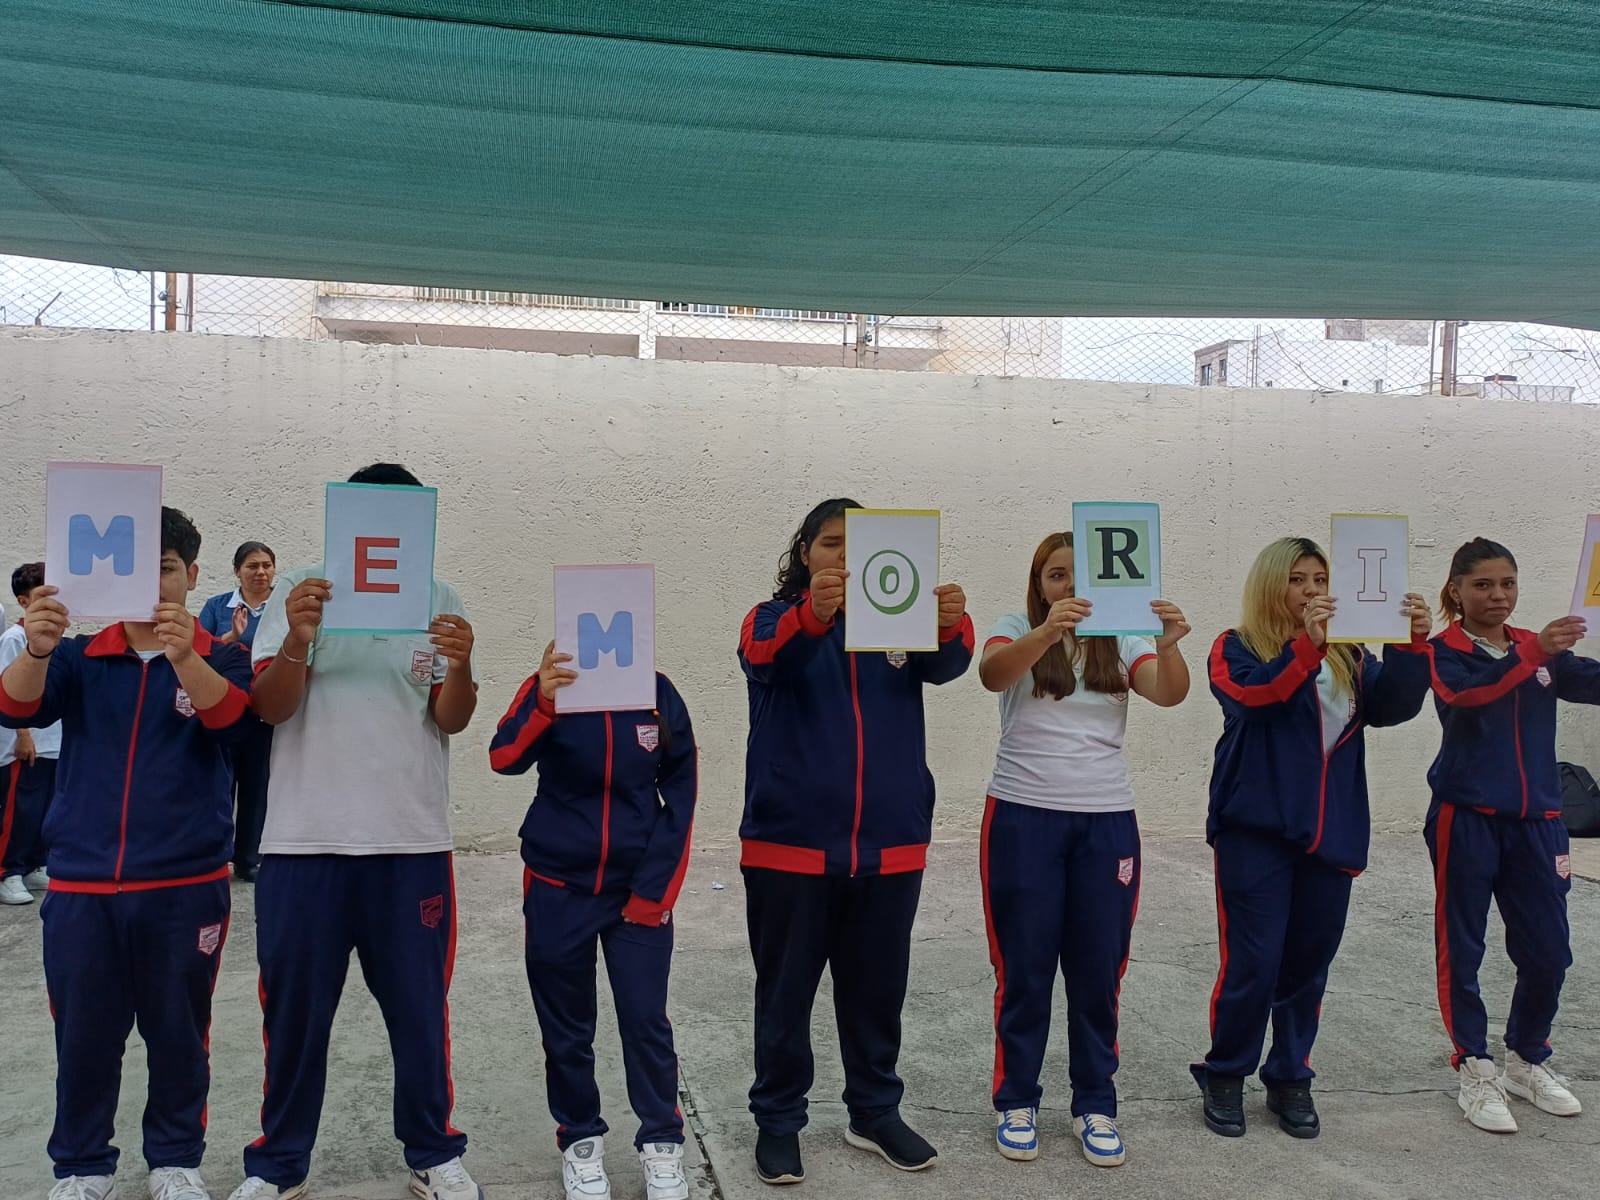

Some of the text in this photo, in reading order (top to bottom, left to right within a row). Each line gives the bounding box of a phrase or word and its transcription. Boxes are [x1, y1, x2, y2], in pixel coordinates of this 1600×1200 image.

[68, 513, 135, 577] M
[355, 537, 399, 593] E
[1094, 527, 1145, 580] R
[862, 549, 921, 616] O
[1357, 548, 1388, 603] I
[577, 611, 634, 670] M
